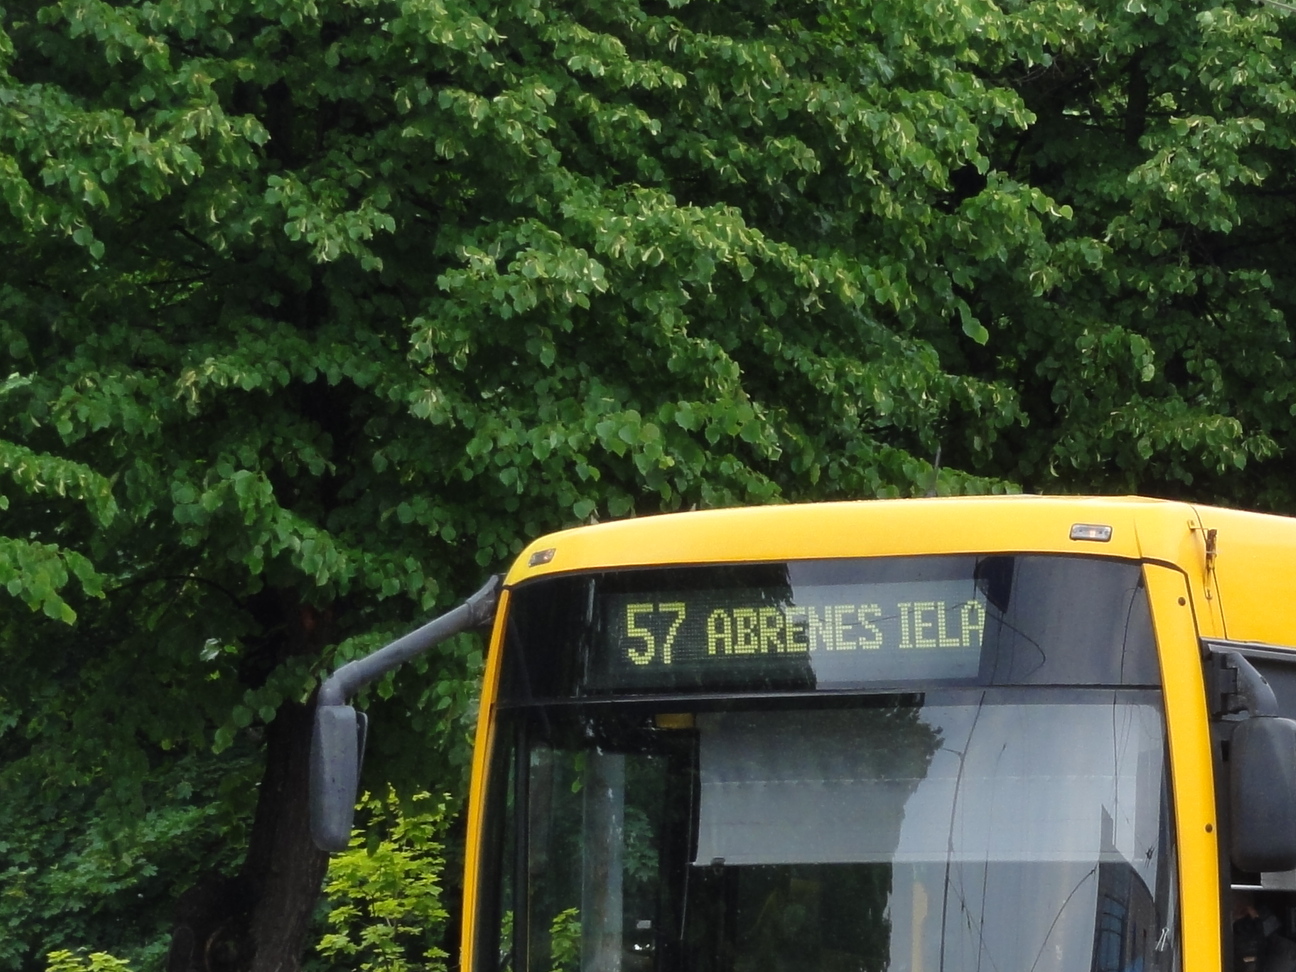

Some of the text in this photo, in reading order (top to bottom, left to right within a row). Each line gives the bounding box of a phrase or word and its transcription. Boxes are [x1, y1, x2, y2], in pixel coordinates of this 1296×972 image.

[626, 599, 986, 665] 57 ABRENES IELA
